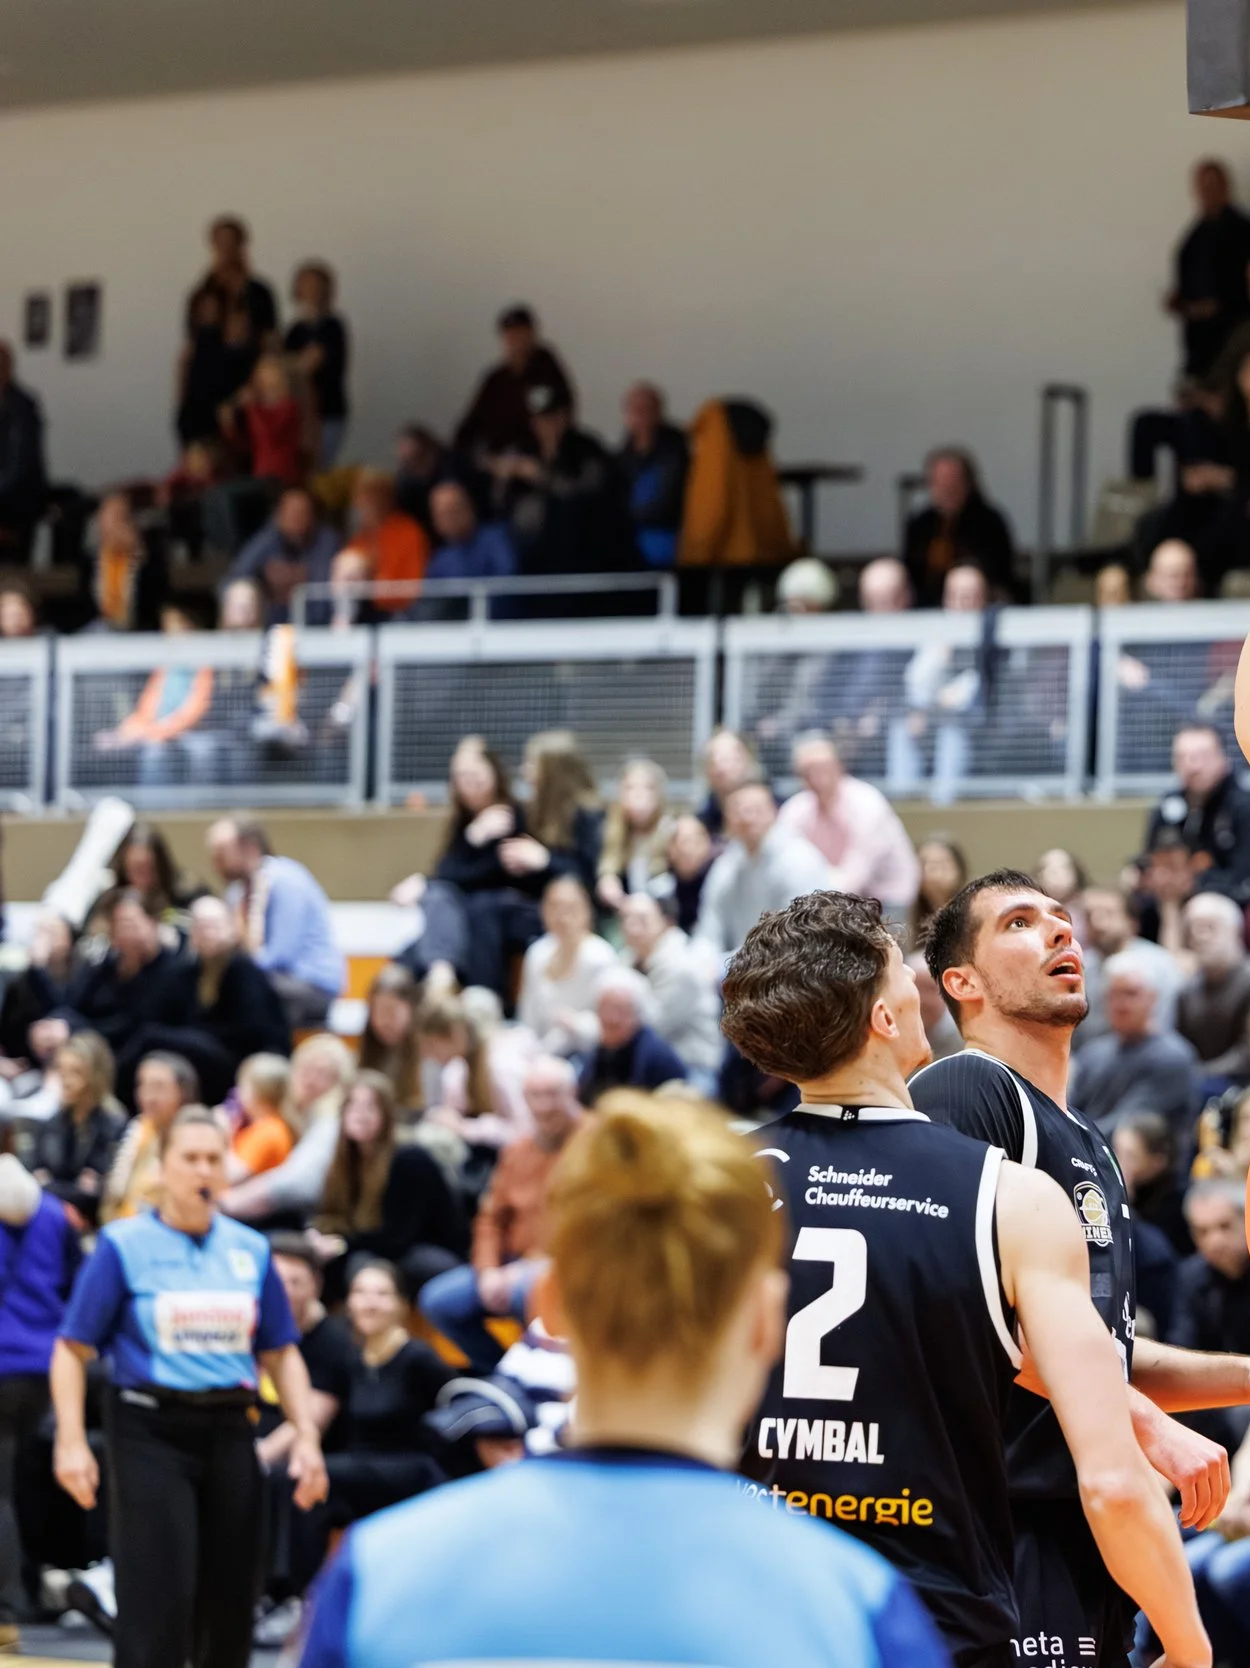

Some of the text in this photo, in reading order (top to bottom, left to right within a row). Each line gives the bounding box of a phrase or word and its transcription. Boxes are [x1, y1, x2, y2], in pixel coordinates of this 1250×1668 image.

[808, 1166, 893, 1187] Schneider
[805, 1187, 949, 1219] Chauffeurservice
[783, 1227, 868, 1401] 2
[758, 1418, 885, 1464] CYMBAL
